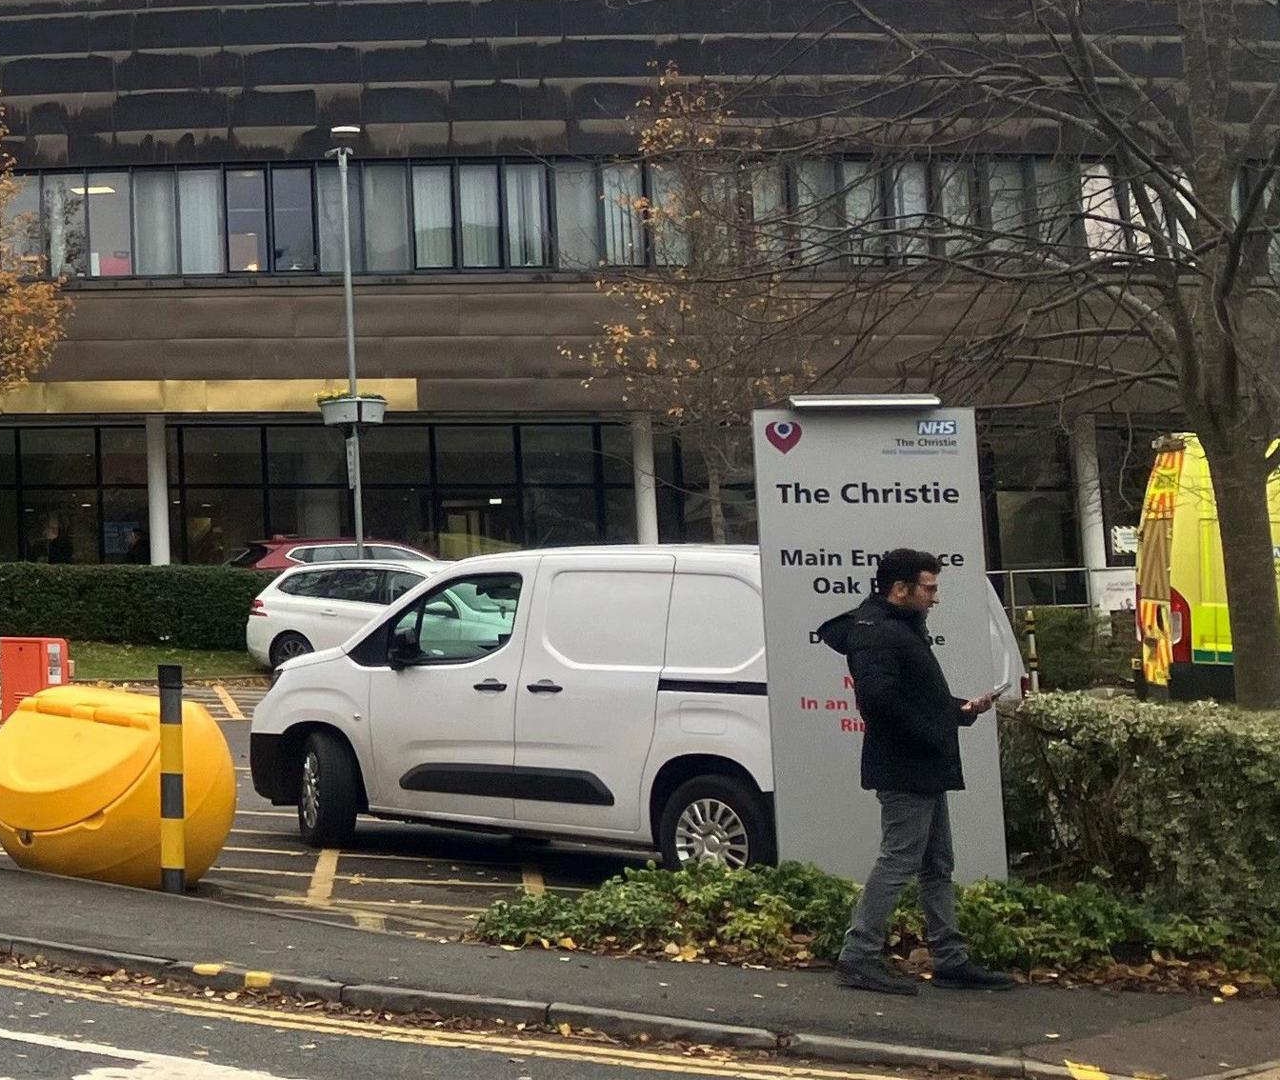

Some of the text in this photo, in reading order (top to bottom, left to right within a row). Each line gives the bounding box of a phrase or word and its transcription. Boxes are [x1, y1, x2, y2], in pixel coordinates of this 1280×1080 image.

[918, 421, 955, 434] NHS
[896, 437, 958, 447] The Christie
[776, 481, 960, 504] The Christie
[780, 548, 965, 567] Main Ence
[812, 576, 861, 594] Oak
[800, 696, 818, 710] In
[825, 699, 848, 711] an
